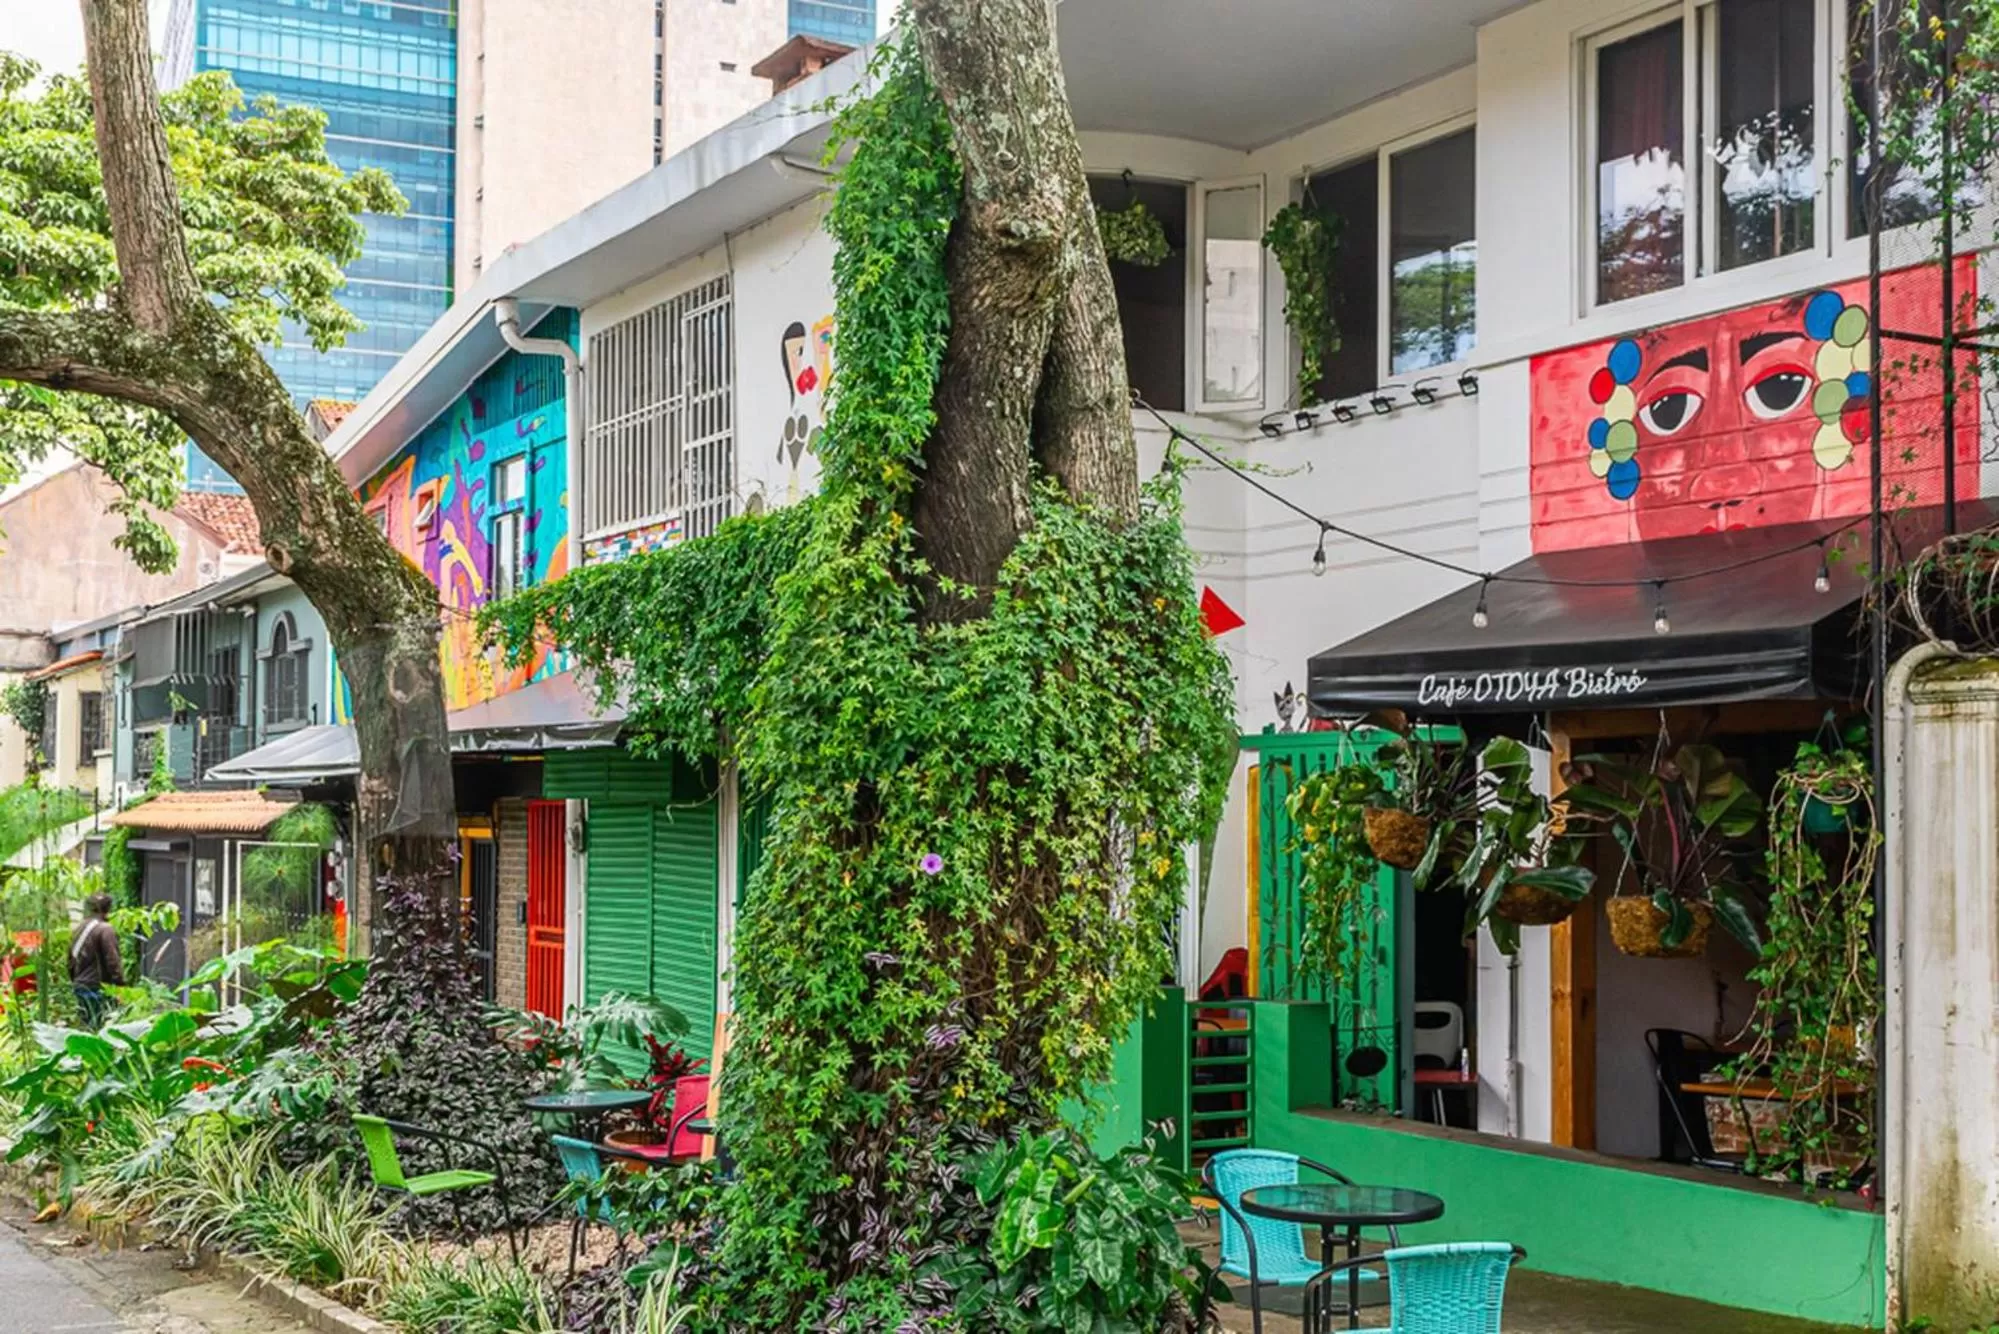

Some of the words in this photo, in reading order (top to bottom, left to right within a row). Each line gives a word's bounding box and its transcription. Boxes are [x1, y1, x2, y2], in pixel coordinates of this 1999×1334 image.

[1417, 674, 1472, 707] Café
[1473, 668, 1560, 702] OTOYA
[1564, 666, 1647, 698] Bistró
